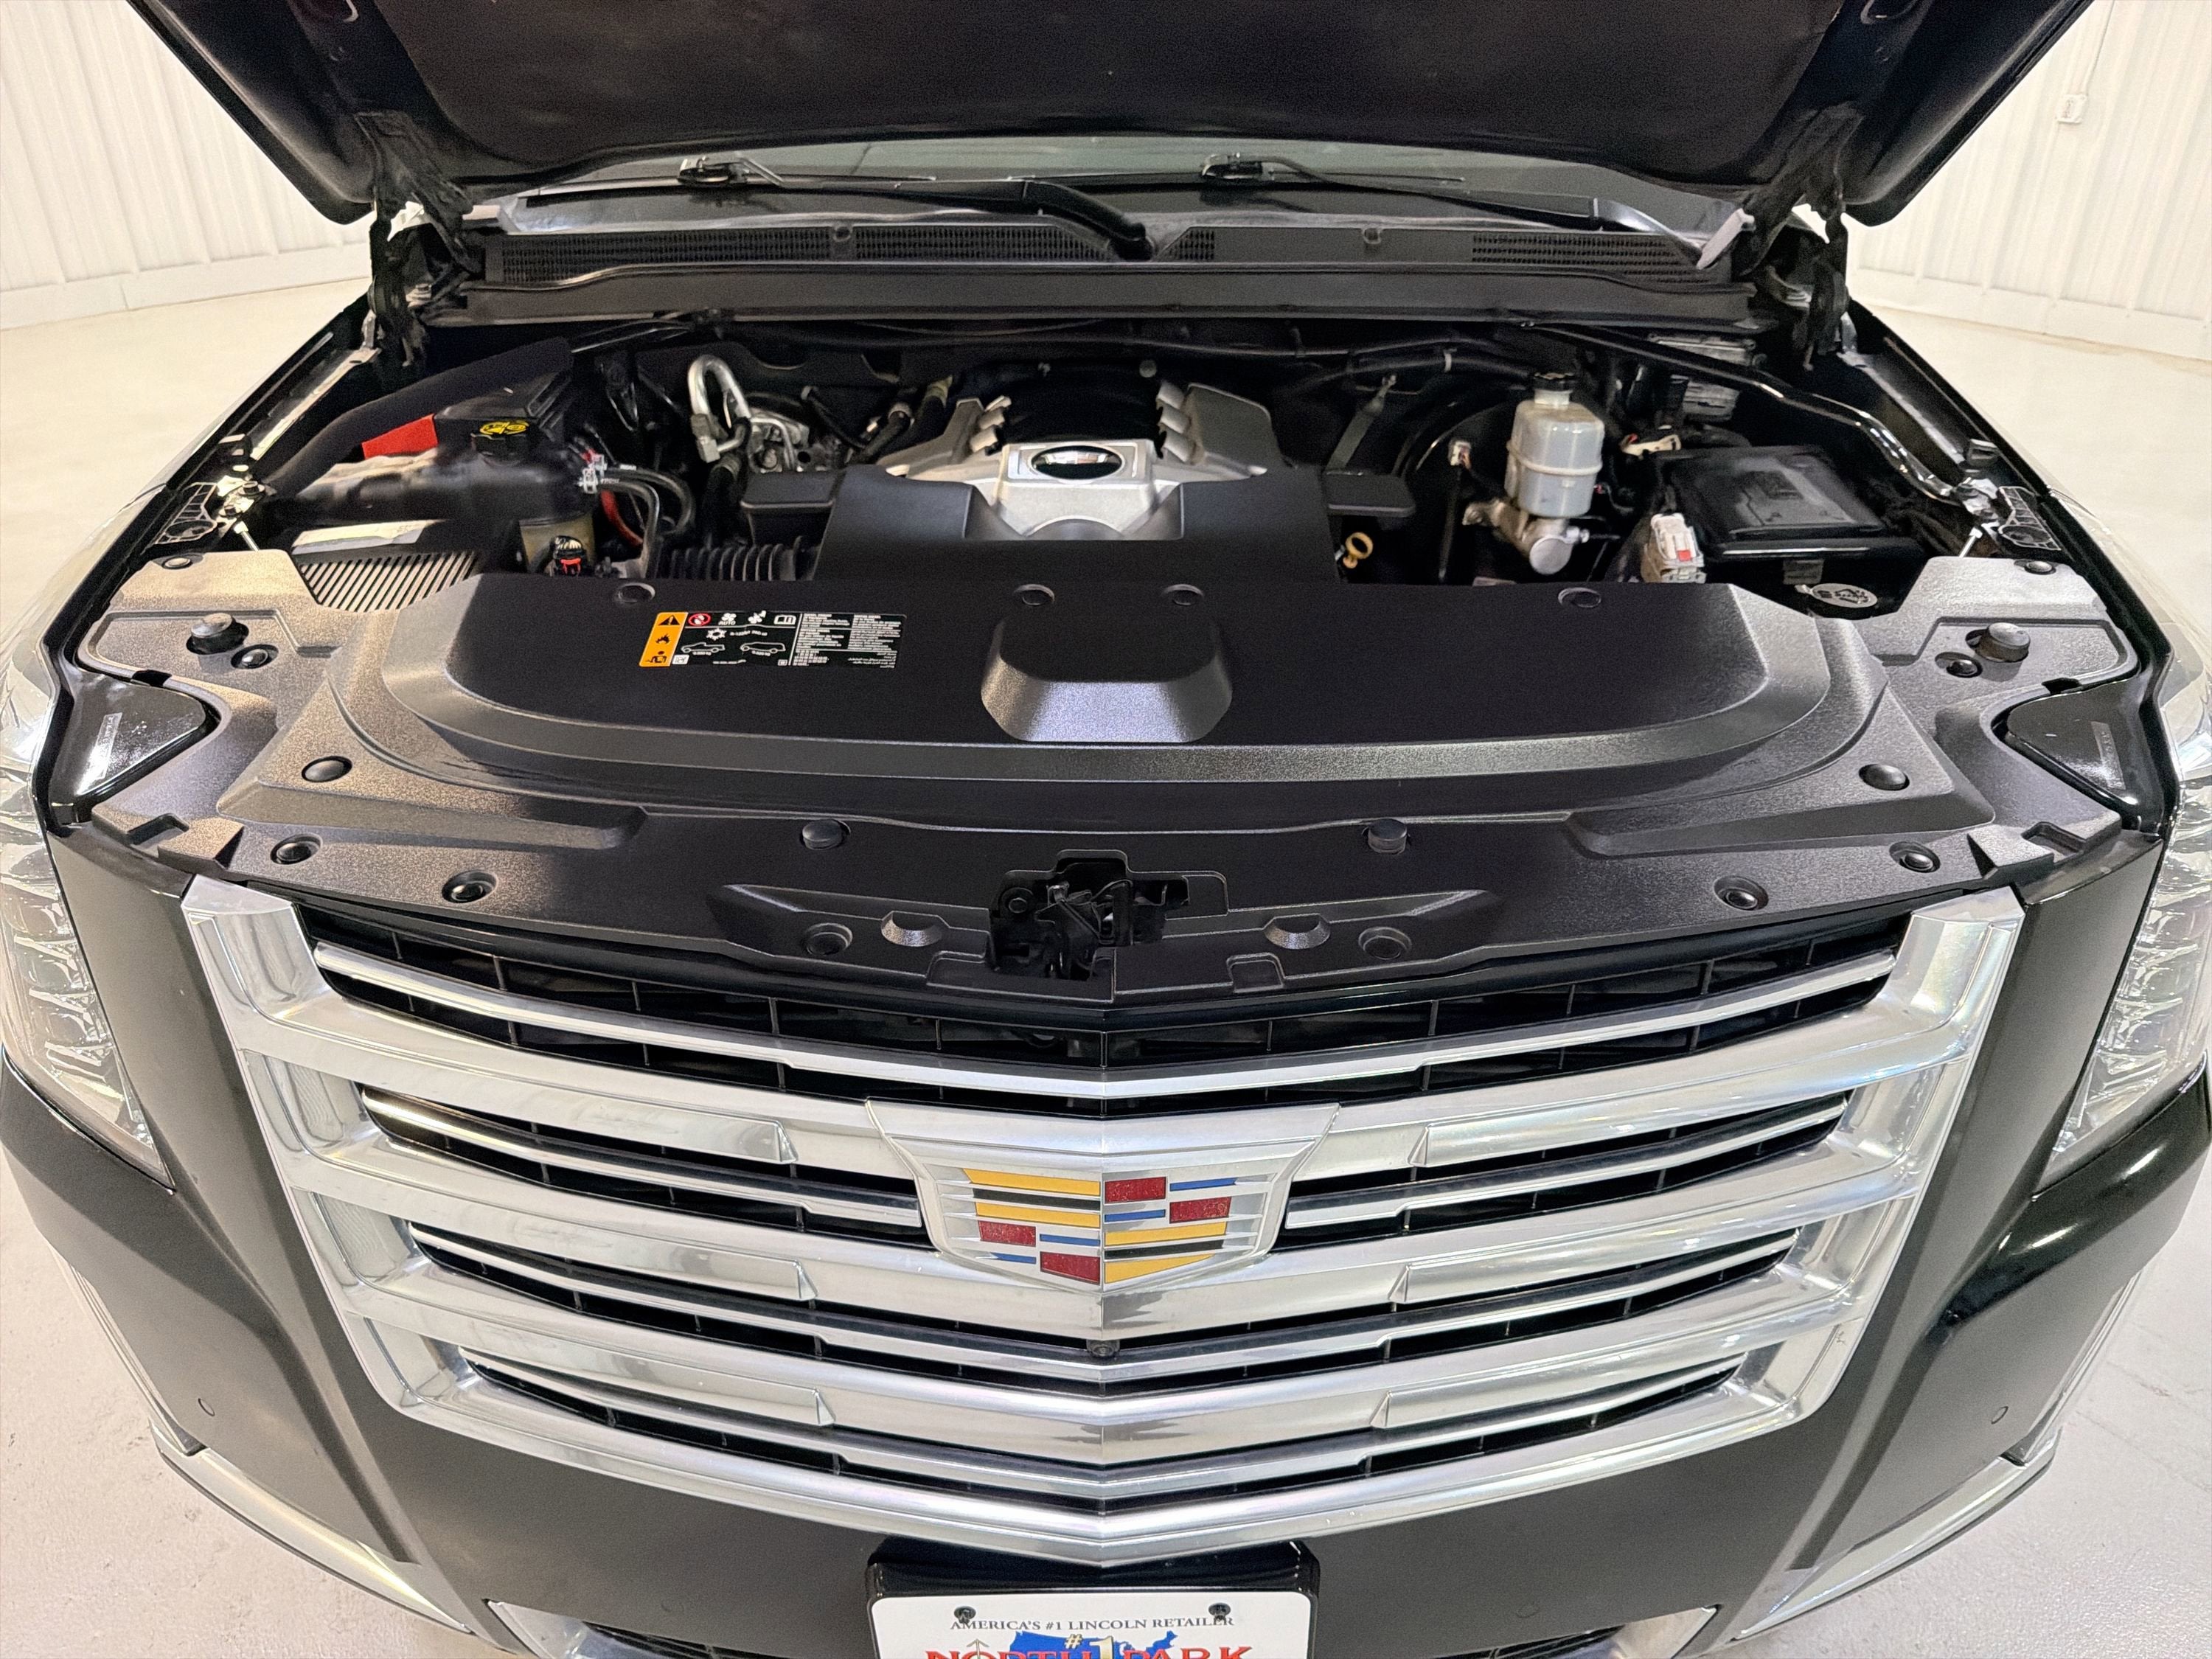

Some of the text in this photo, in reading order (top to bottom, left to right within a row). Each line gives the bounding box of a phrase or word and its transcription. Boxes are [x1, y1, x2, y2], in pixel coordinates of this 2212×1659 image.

[950, 1617, 1235, 1630] AMERICA'S #1 LINCOLN RETAILER
